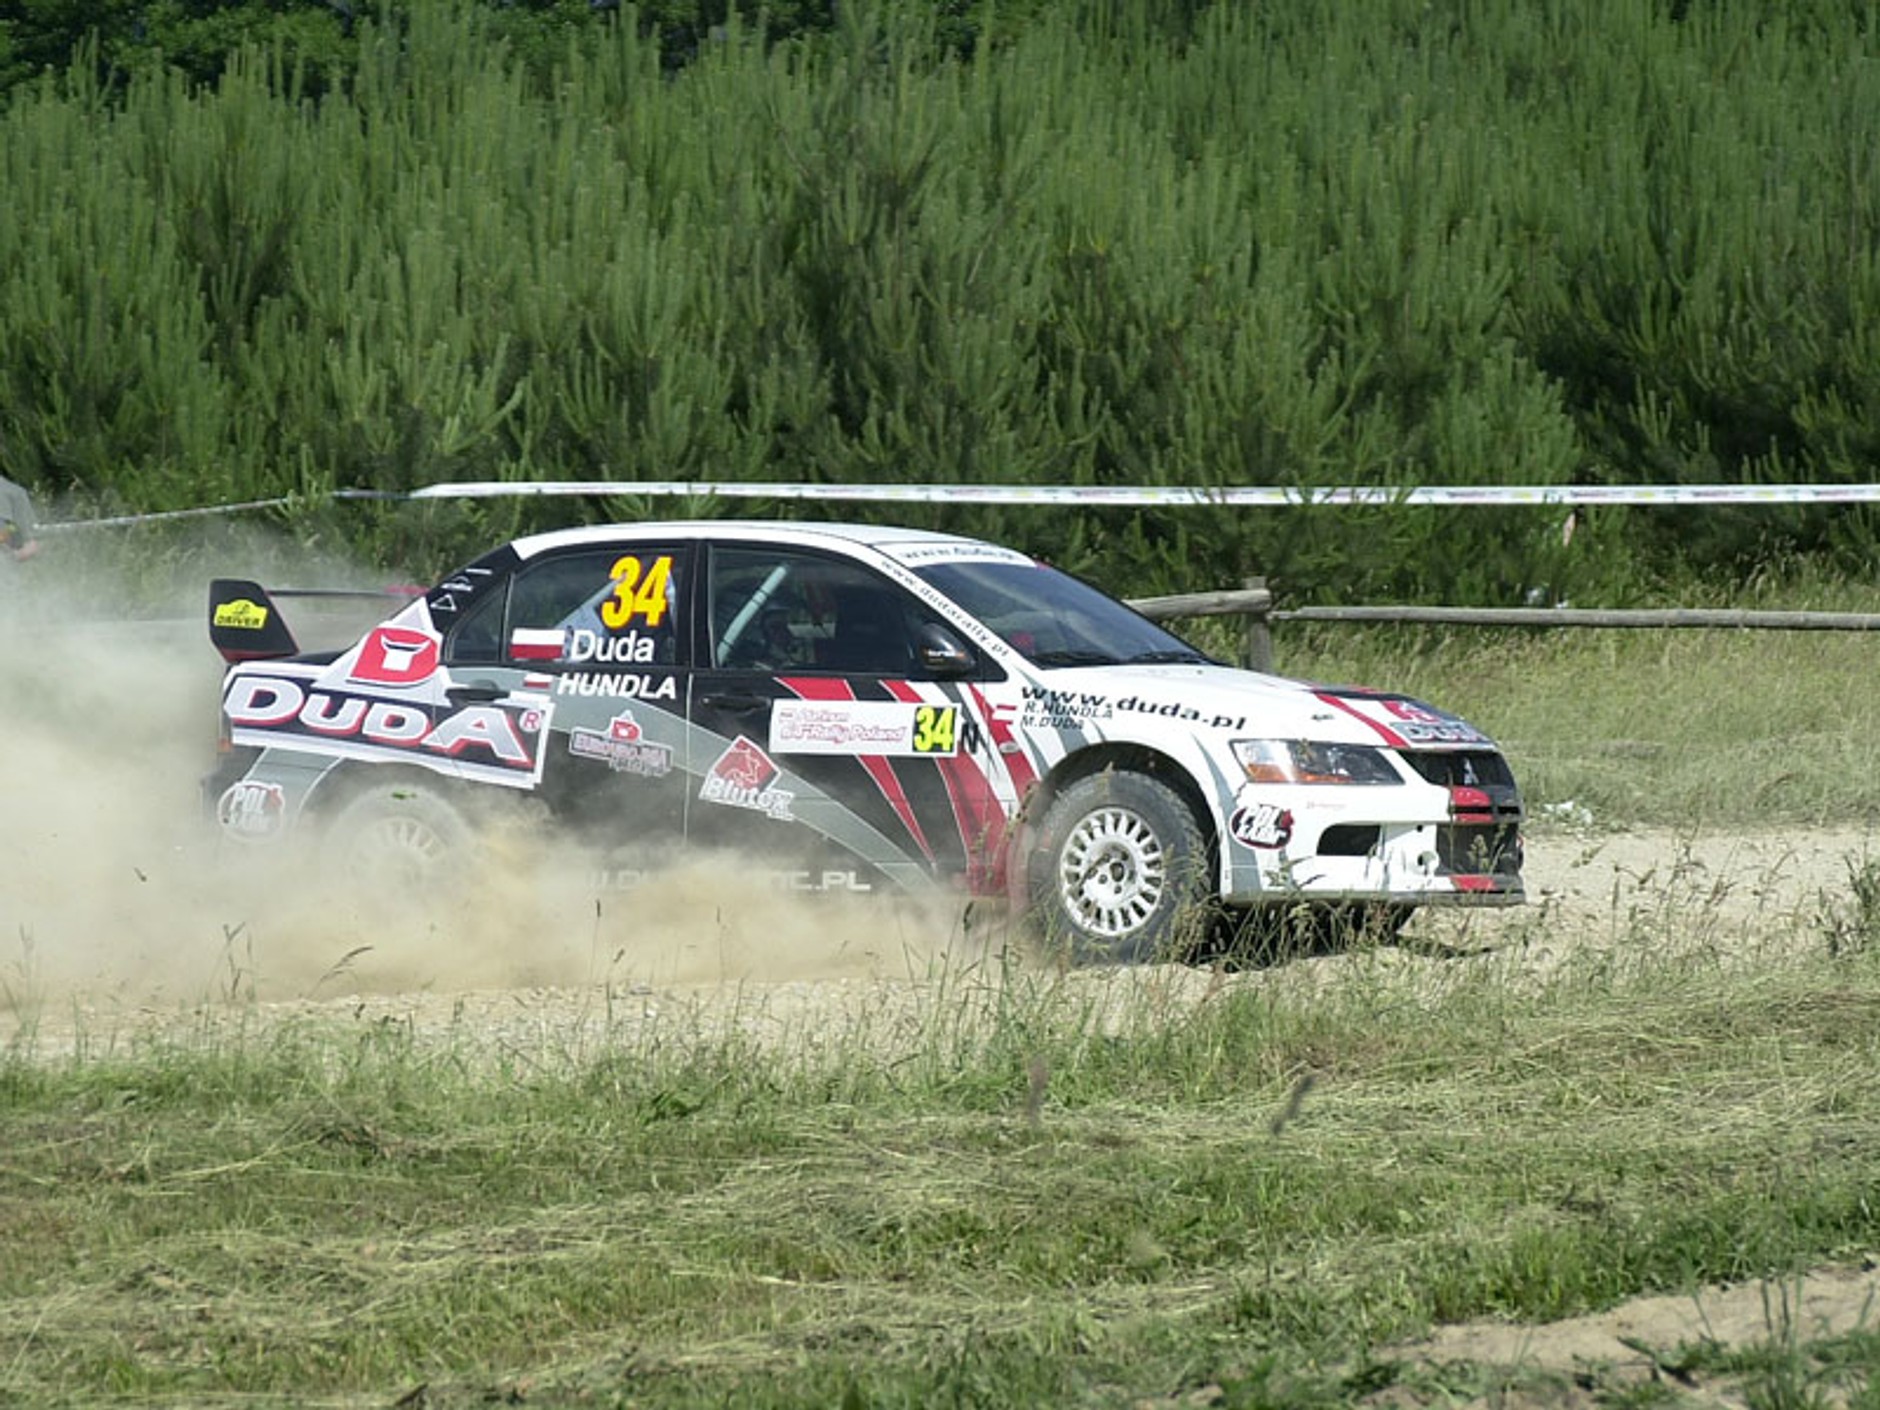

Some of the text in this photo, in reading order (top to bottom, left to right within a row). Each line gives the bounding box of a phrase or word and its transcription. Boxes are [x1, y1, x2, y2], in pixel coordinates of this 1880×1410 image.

[601, 555, 673, 629] 34
[217, 615, 261, 627] DRIVER
[569, 629, 655, 663] Duda
[557, 672, 677, 700] HUNDLA
[223, 676, 535, 769] DUDA
[1021, 686, 1247, 731] www.duda.pl
[848, 725, 907, 742] Poland
[913, 705, 954, 752] 34
